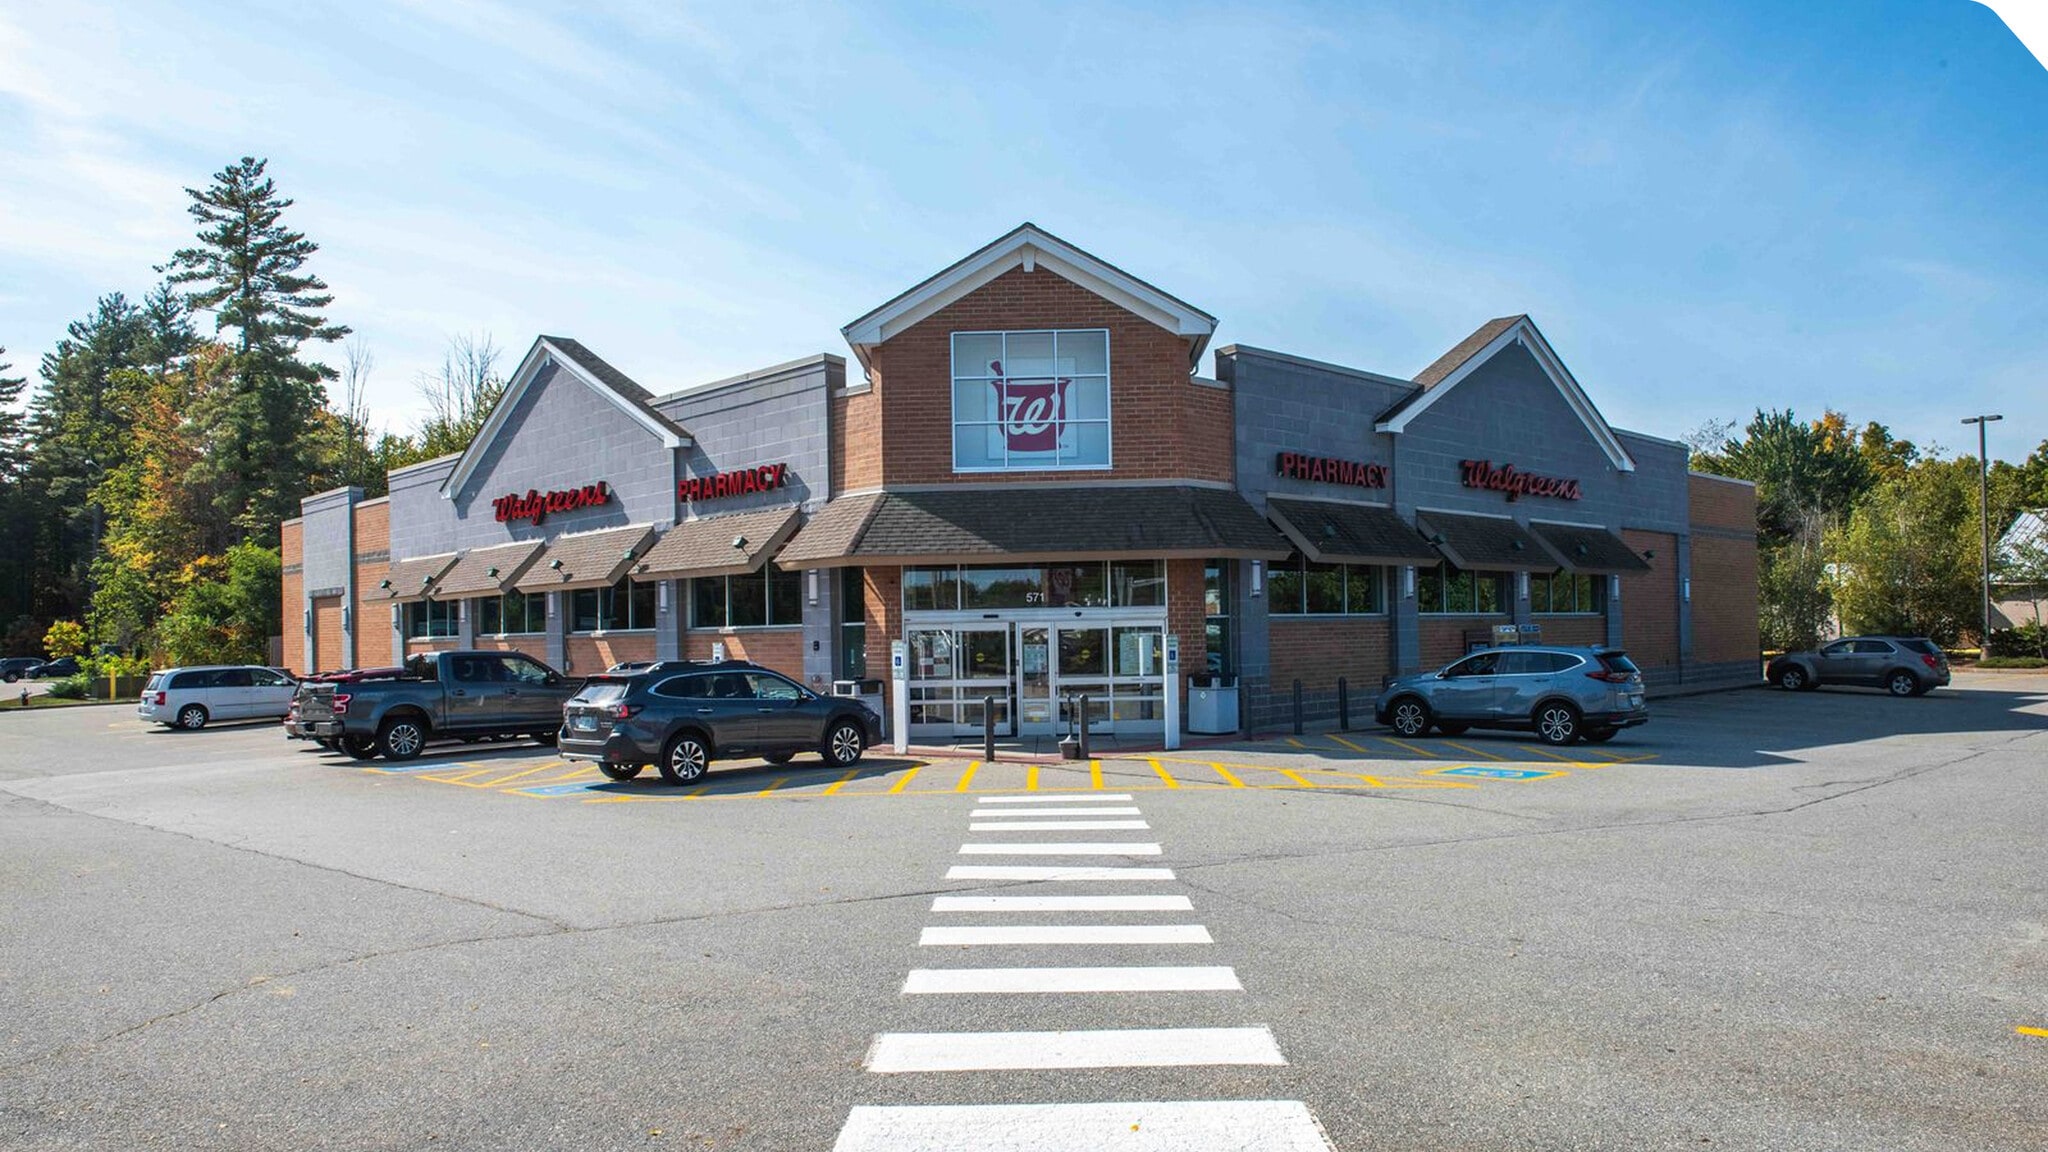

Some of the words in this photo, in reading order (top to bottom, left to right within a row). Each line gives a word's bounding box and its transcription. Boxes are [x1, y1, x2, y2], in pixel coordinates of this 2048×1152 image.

[677, 463, 787, 502] PHARMACY
[1279, 452, 1391, 489] PHARMACY
[1461, 460, 1583, 502] Walgreens
[492, 481, 611, 526] Walgreens
[1025, 592, 1045, 603] 571
